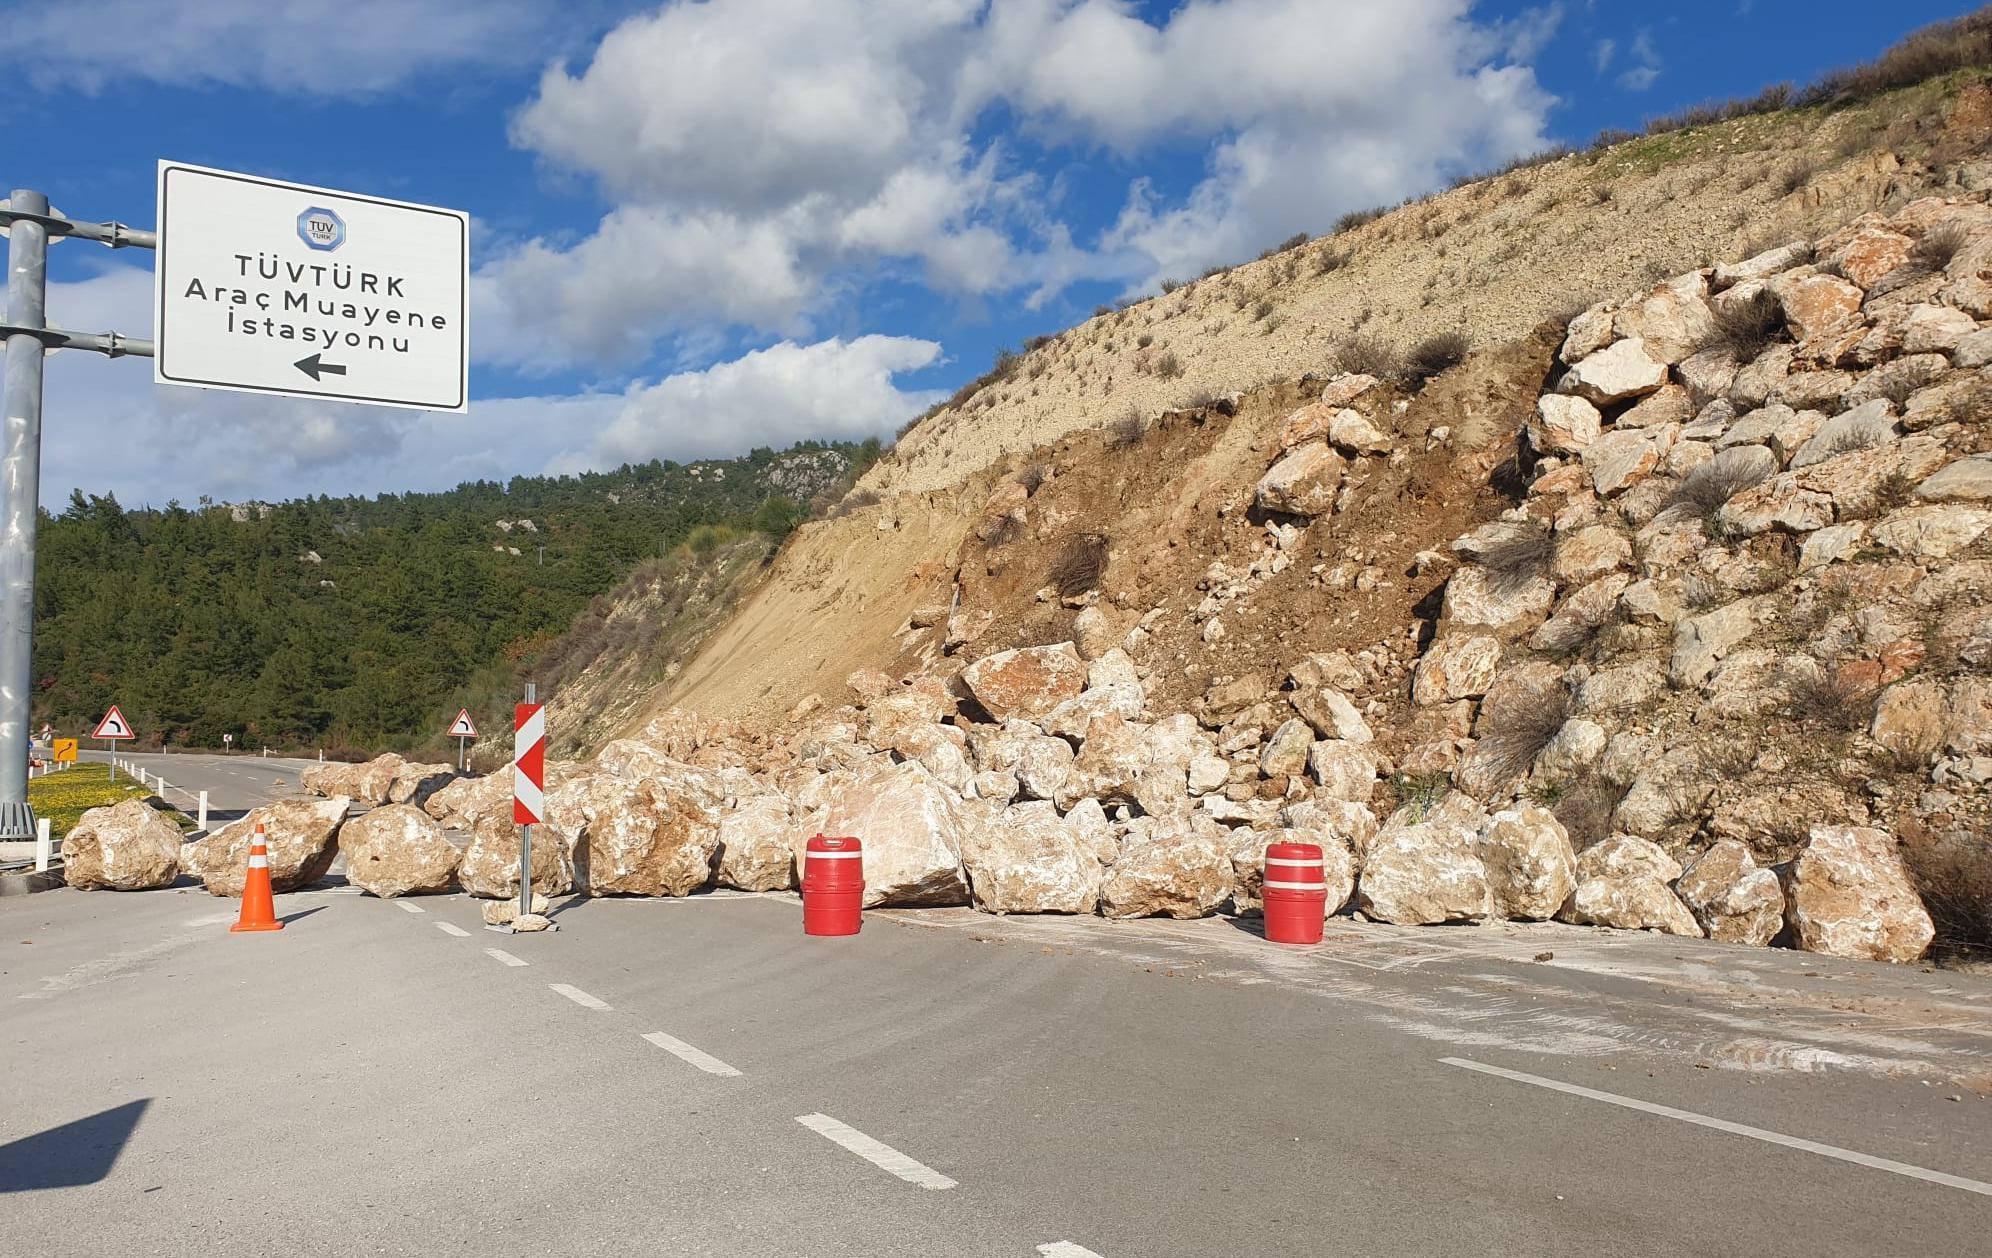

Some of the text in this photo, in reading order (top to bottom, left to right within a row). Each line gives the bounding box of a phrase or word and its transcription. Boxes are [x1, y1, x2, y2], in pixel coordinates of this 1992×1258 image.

[235, 252, 405, 298] TÜVTÜRK
[184, 278, 447, 331] Araç Muayene
[228, 306, 409, 353] İstasyonu
